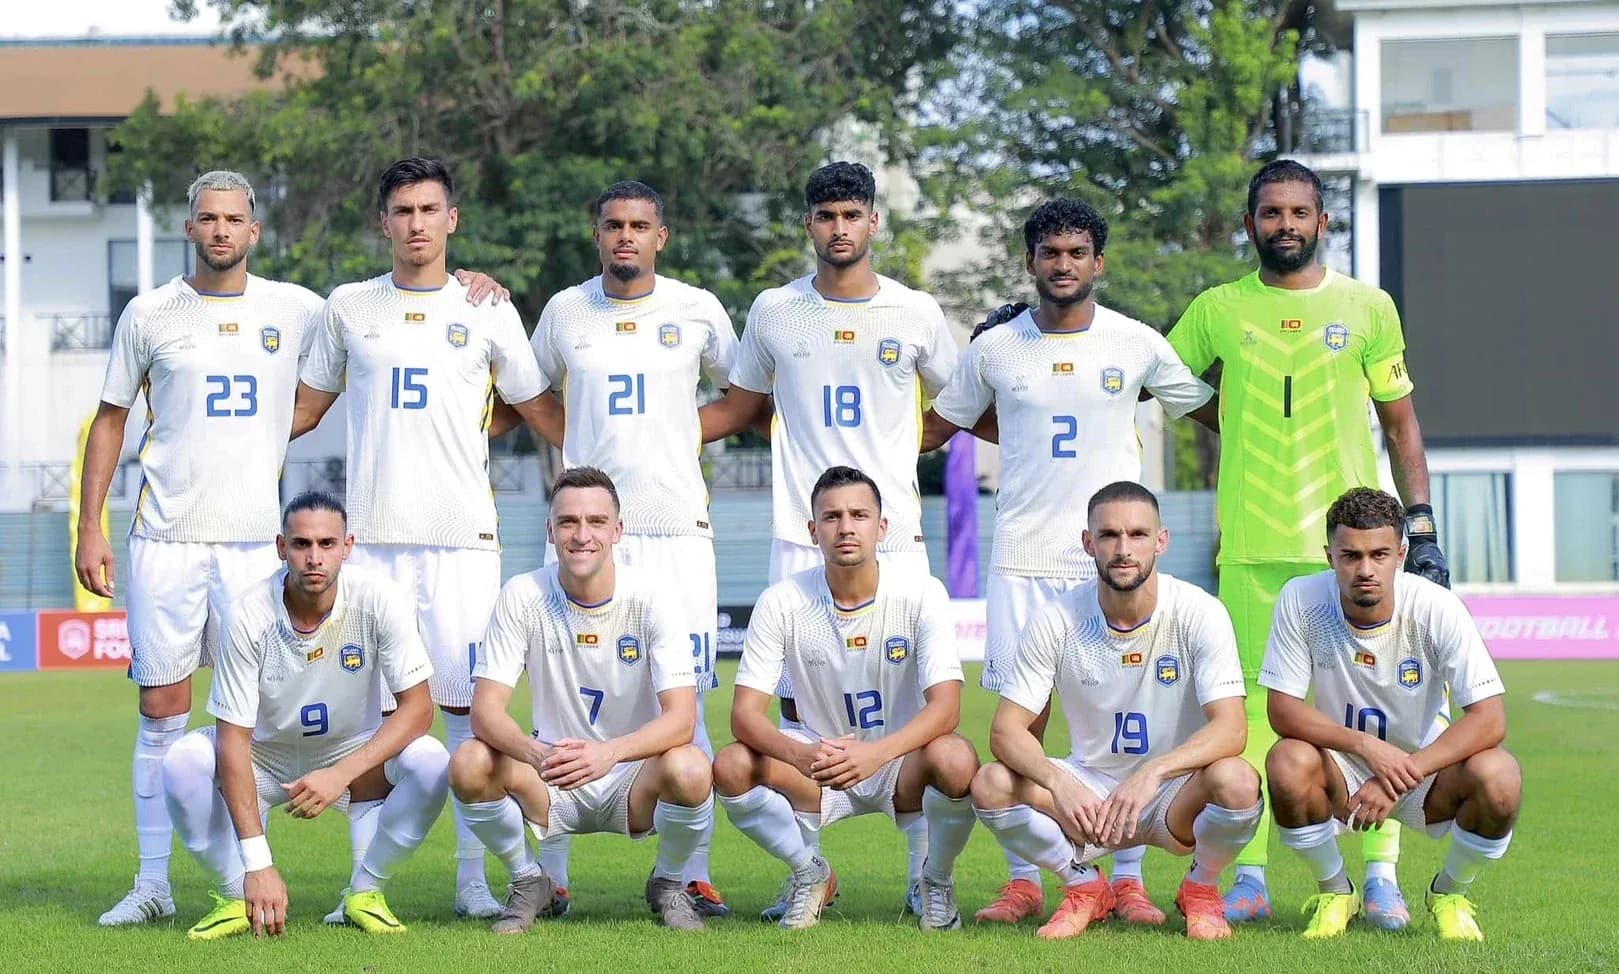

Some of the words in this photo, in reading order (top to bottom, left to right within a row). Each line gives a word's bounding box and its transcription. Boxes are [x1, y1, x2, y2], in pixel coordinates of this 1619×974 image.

[206, 375, 257, 417] 23
[391, 367, 428, 410] 15
[609, 374, 645, 416] 21
[823, 384, 863, 428] 18
[1284, 375, 1292, 418] 1
[1051, 415, 1078, 459] 2
[300, 703, 329, 738] 9
[580, 687, 604, 726] 7
[844, 689, 884, 730] 12
[1345, 703, 1387, 741] 10
[1111, 711, 1150, 756] 19
